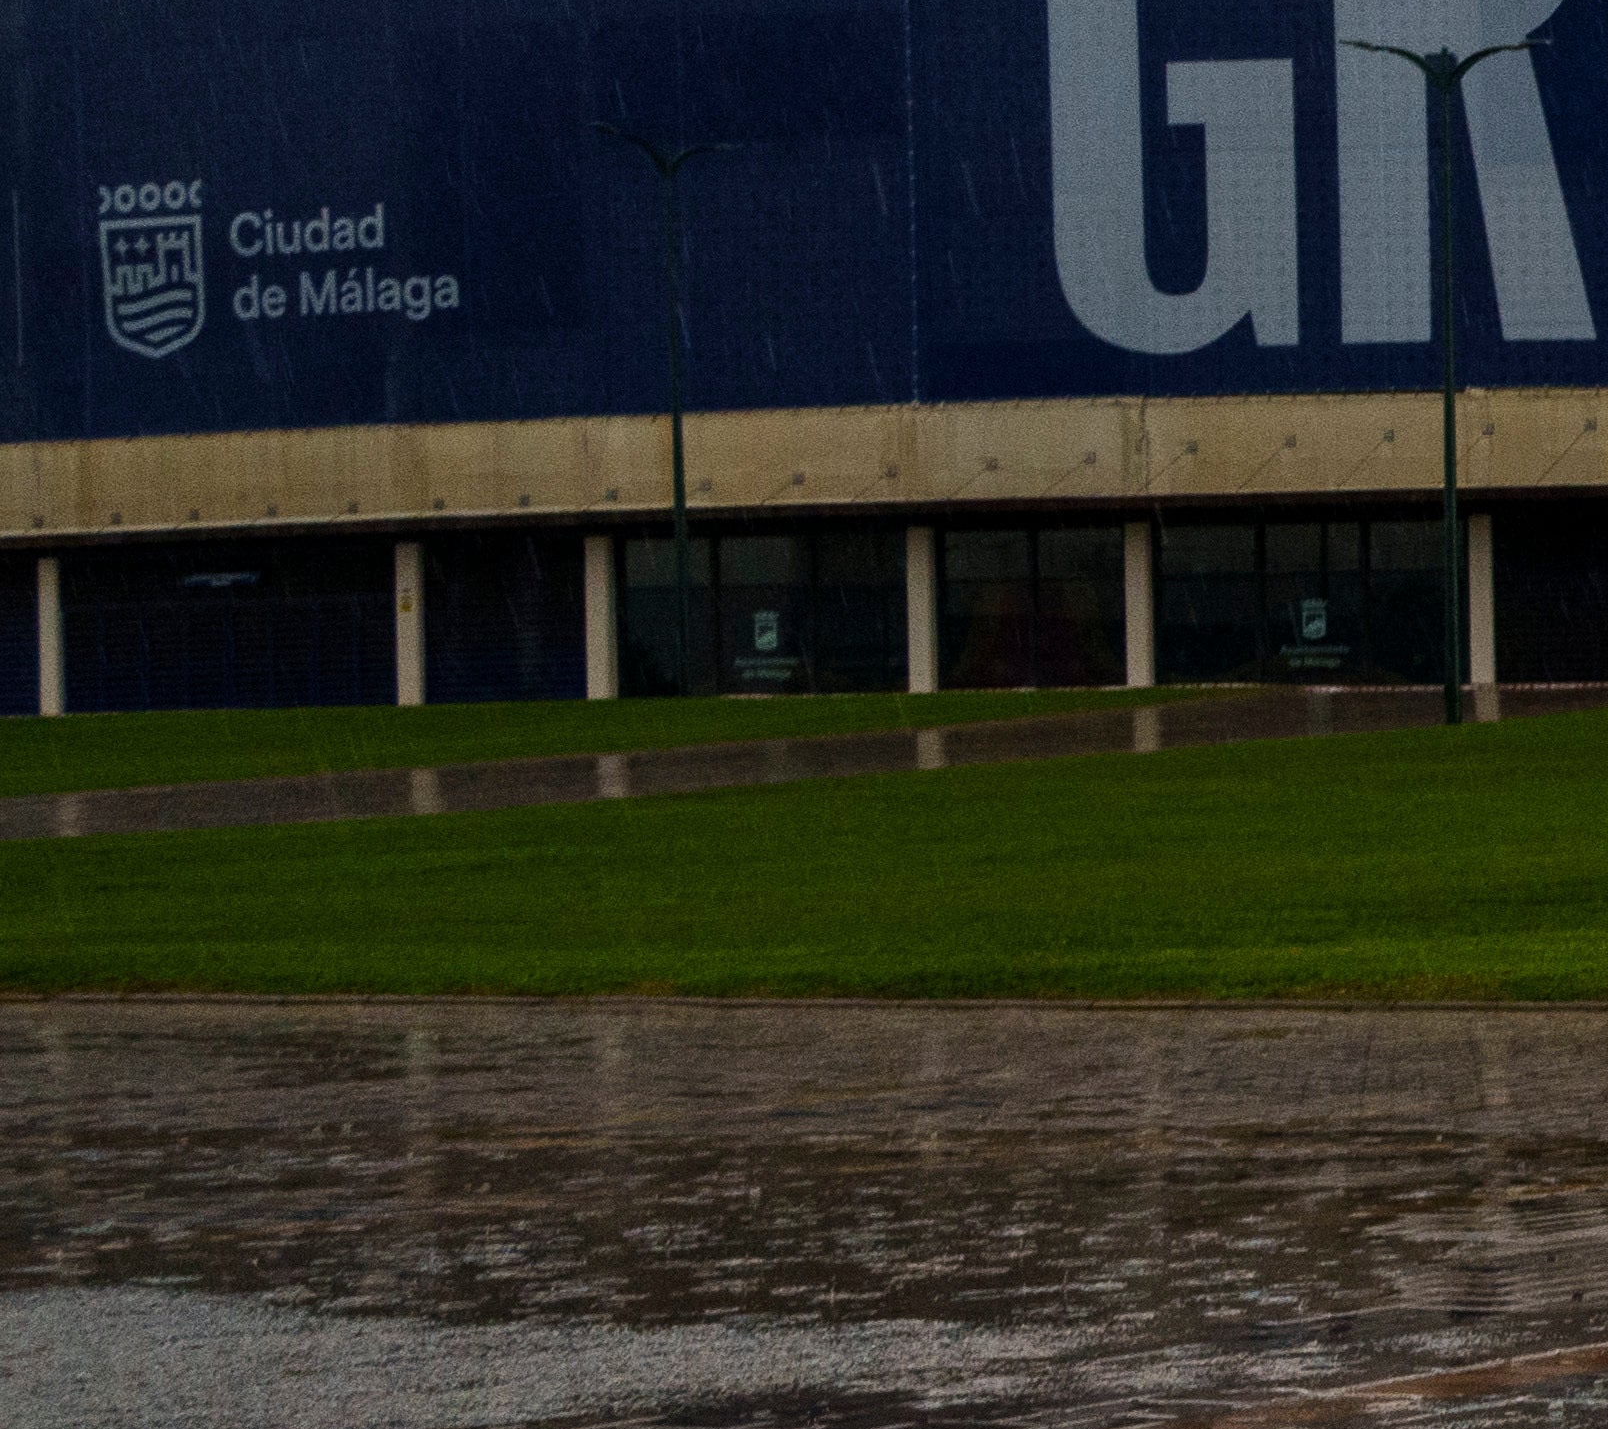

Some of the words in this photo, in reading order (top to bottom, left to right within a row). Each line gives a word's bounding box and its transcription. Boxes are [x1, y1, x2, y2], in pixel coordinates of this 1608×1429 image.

[229, 203, 385, 256] Ciudad
[233, 275, 286, 320] de
[300, 267, 460, 320] Málaga
